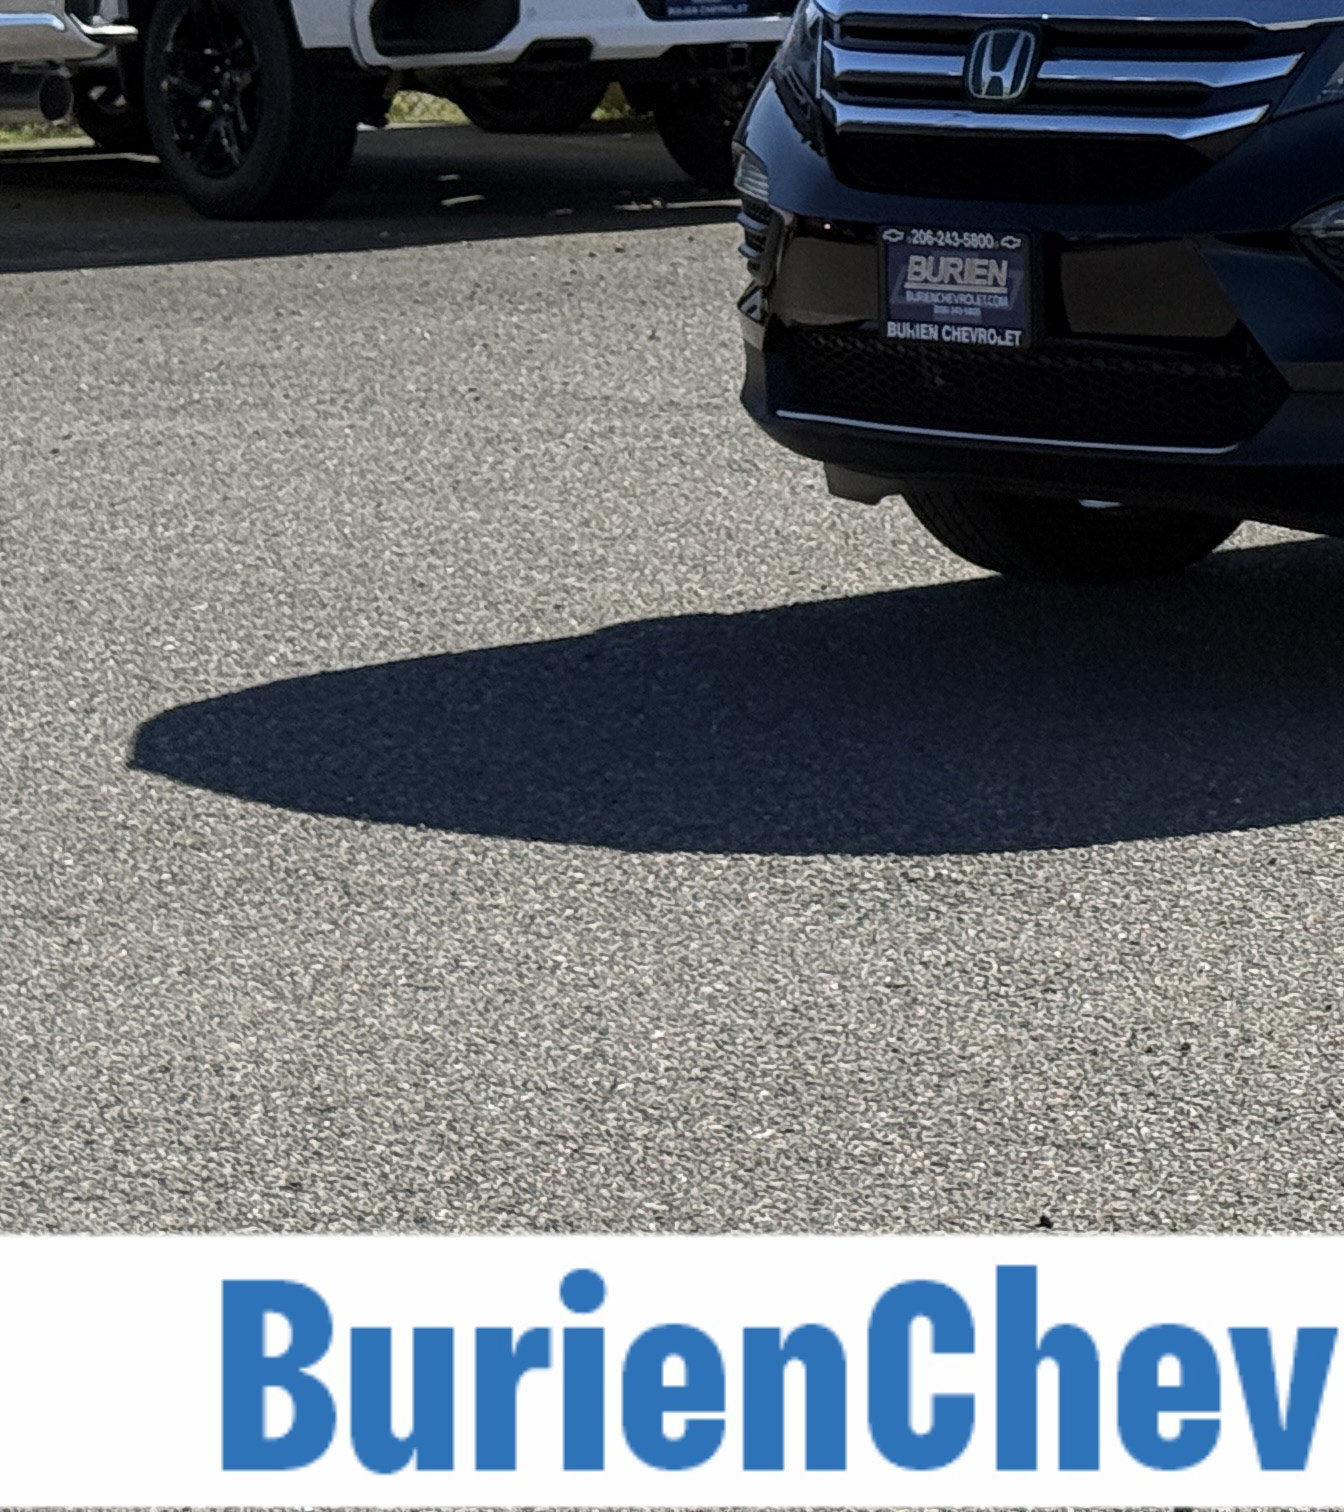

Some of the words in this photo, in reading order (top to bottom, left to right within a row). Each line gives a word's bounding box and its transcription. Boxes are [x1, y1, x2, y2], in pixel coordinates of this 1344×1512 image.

[910, 228, 995, 249] 206-243-5800
[906, 254, 1009, 287] BURIEN
[886, 320, 939, 342] BURIEN
[941, 324, 1022, 348] CHEVROLET
